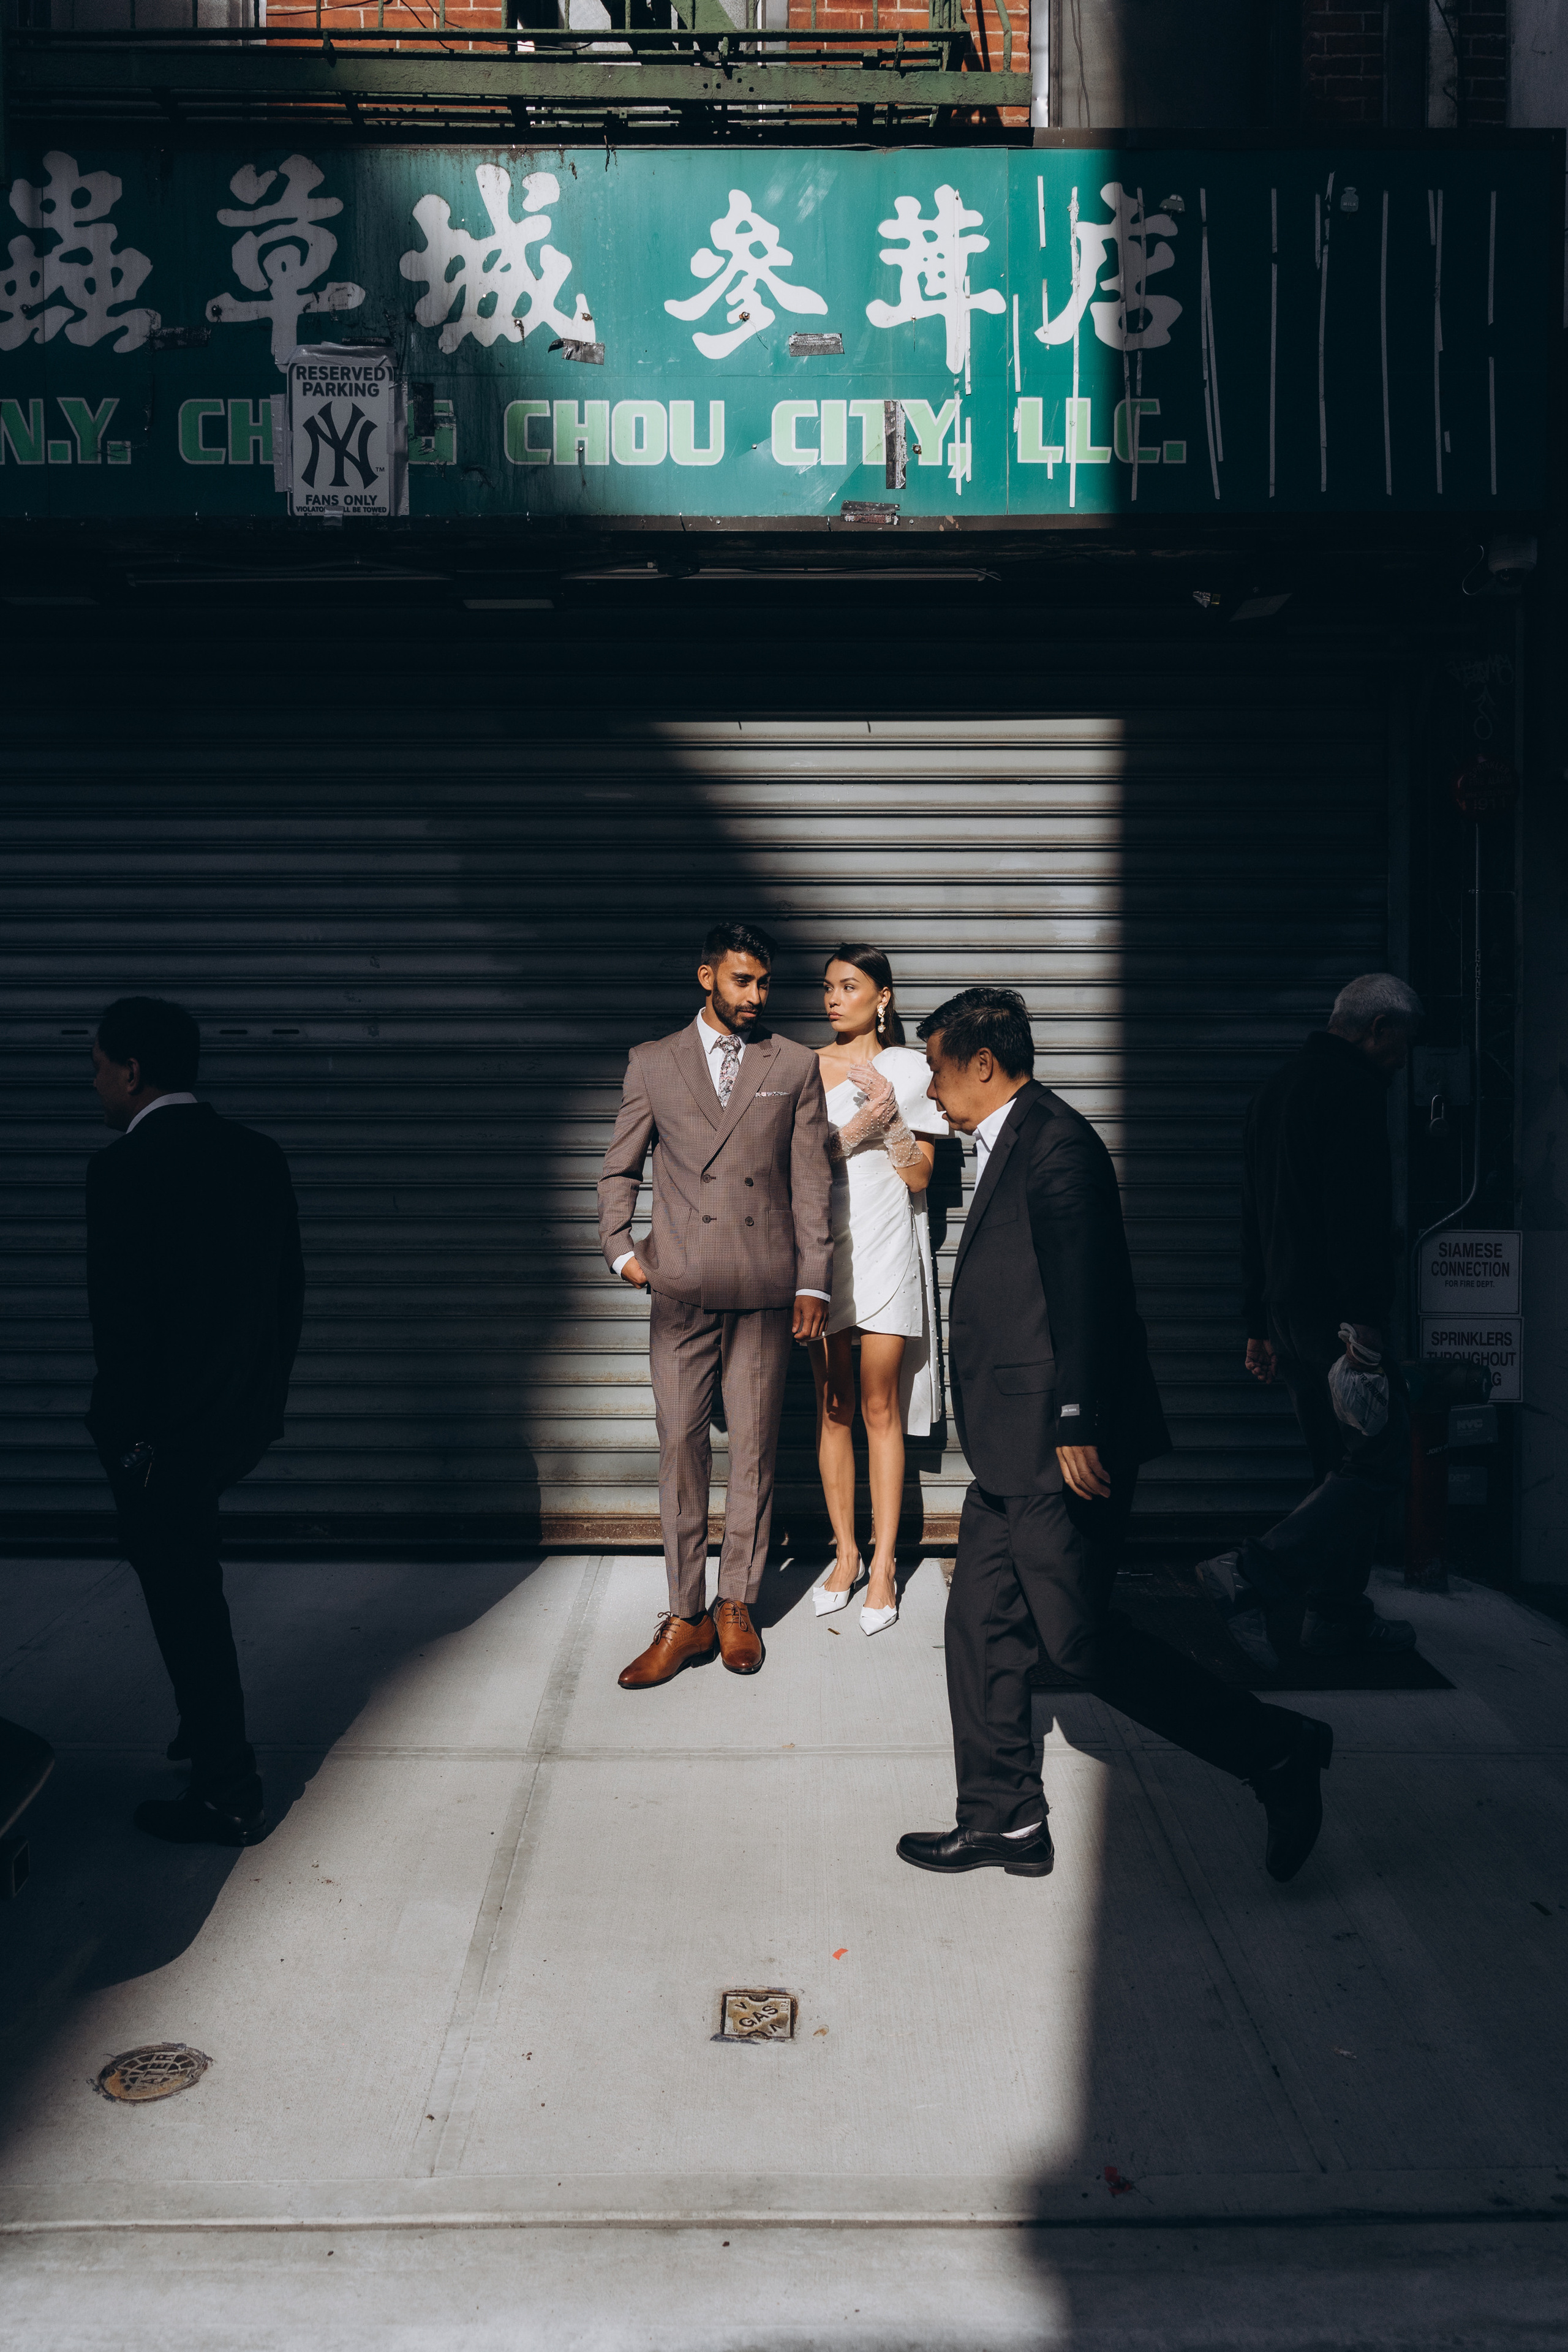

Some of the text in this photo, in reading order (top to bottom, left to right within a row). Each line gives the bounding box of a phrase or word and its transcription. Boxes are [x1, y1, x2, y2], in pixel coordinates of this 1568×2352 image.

[296, 366, 386, 381] RESERVED
[302, 382, 380, 397] PARKING
[0, 397, 130, 466] N.Y.
[178, 398, 458, 466] CHG
[503, 399, 725, 467] CHOU
[1017, 396, 1187, 464] LLC.
[306, 495, 378, 505] FANS ONLY
[1469, 761, 1510, 778] SPRINKLER
[1468, 774, 1512, 786] FIRE ALARM
[1439, 1242, 1502, 1258] SIAMESE
[1431, 1261, 1510, 1277] CONNECTION
[1431, 1331, 1512, 1346] SPRINKLERS
[1457, 1419, 1483, 1430] NYC
[1426, 1446, 1443, 1455] JOEY
[1448, 1474, 1471, 1482] DEP
[739, 2005, 778, 2027] GAS
